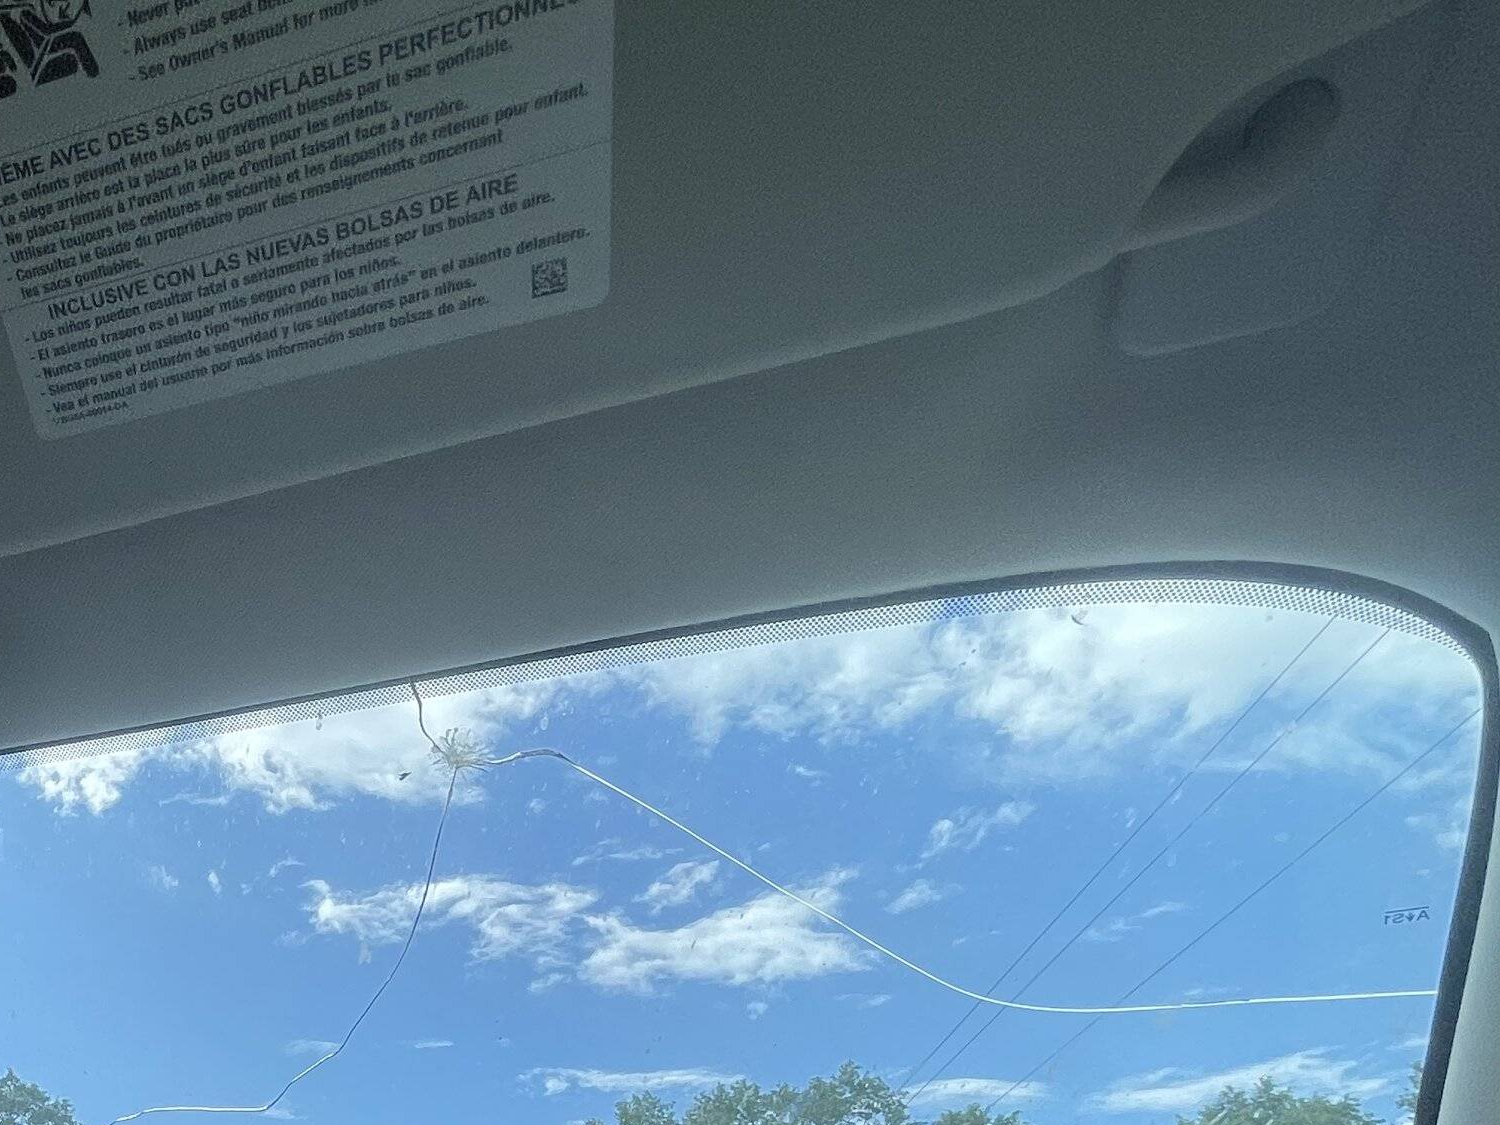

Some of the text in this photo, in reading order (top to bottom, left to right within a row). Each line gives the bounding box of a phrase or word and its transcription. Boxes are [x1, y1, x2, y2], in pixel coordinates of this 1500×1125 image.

[126, 1, 168, 27] Never
[133, 26, 186, 55] Always
[189, 15, 216, 35] use
[220, 1, 254, 25] seat
[137, 0, 358, 81] See Owner's Manual for more
[49, 137, 101, 169] AVEC
[106, 121, 150, 151] DES
[154, 101, 213, 135] SACS
[219, 50, 371, 114] GONFLABLES
[379, 0, 580, 64] PERFECTIONN
[47, 173, 516, 319] INCLUSIVE CON LAS NUEVAS BOLSAS DE AIRE
